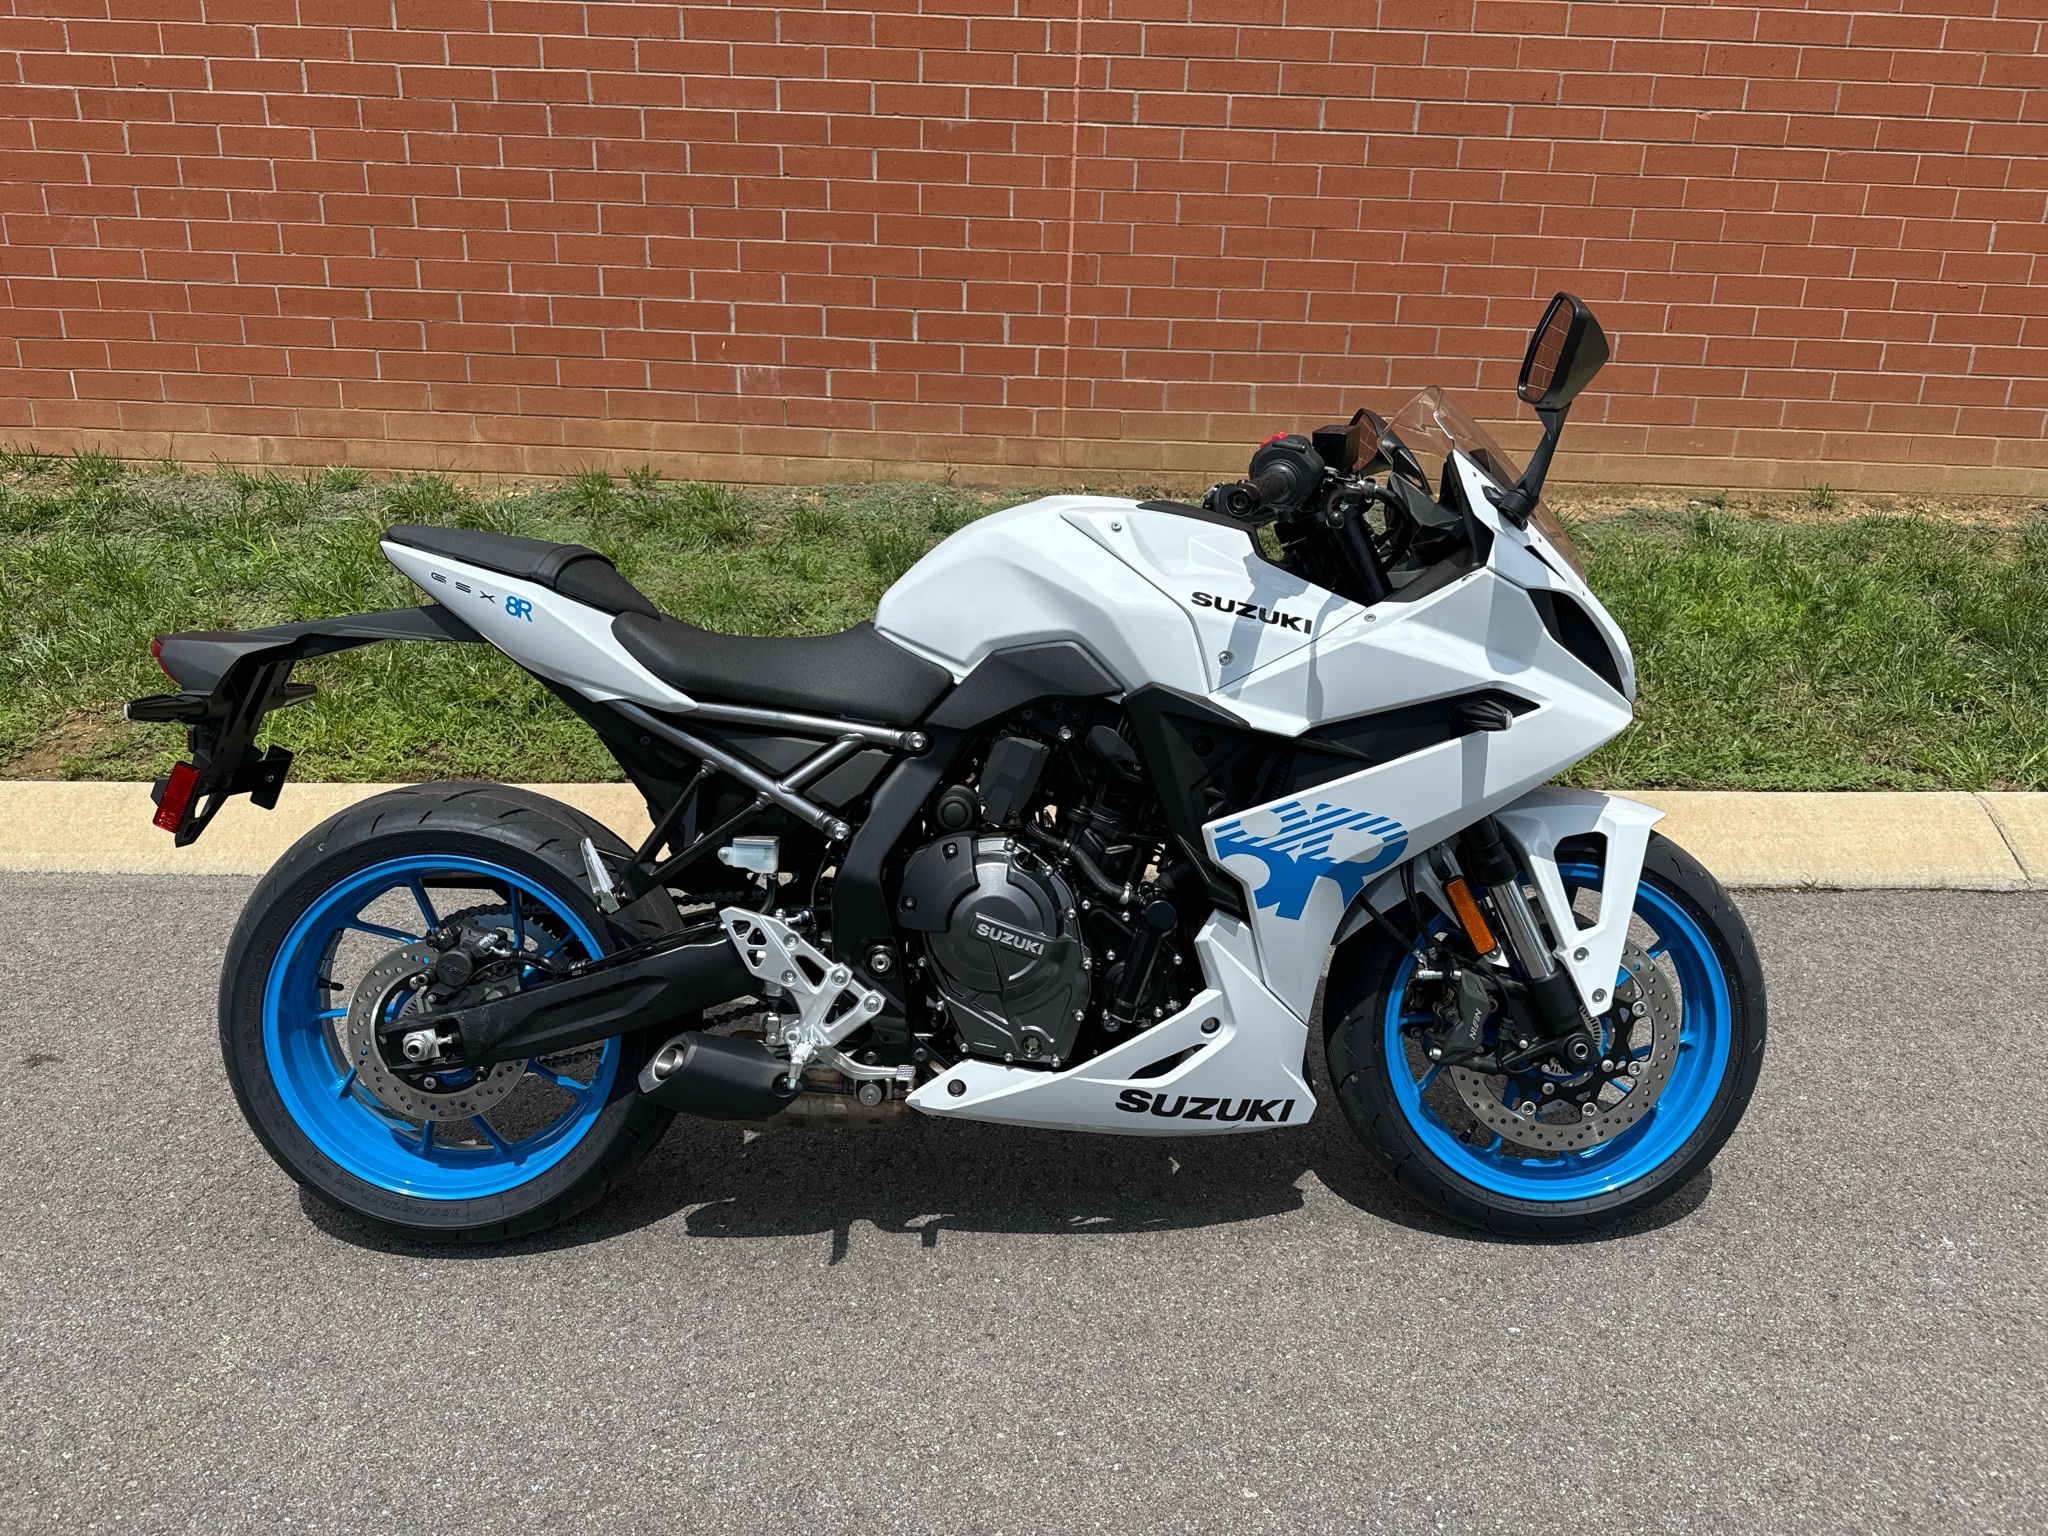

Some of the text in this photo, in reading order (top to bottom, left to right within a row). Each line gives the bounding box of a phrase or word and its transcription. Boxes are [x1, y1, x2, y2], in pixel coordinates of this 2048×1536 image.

[505, 595, 533, 622] 8R
[1190, 591, 1313, 635] SUZUKI
[975, 923, 1045, 955] SUZUKI
[1115, 1088, 1296, 1122] SUZUKI
